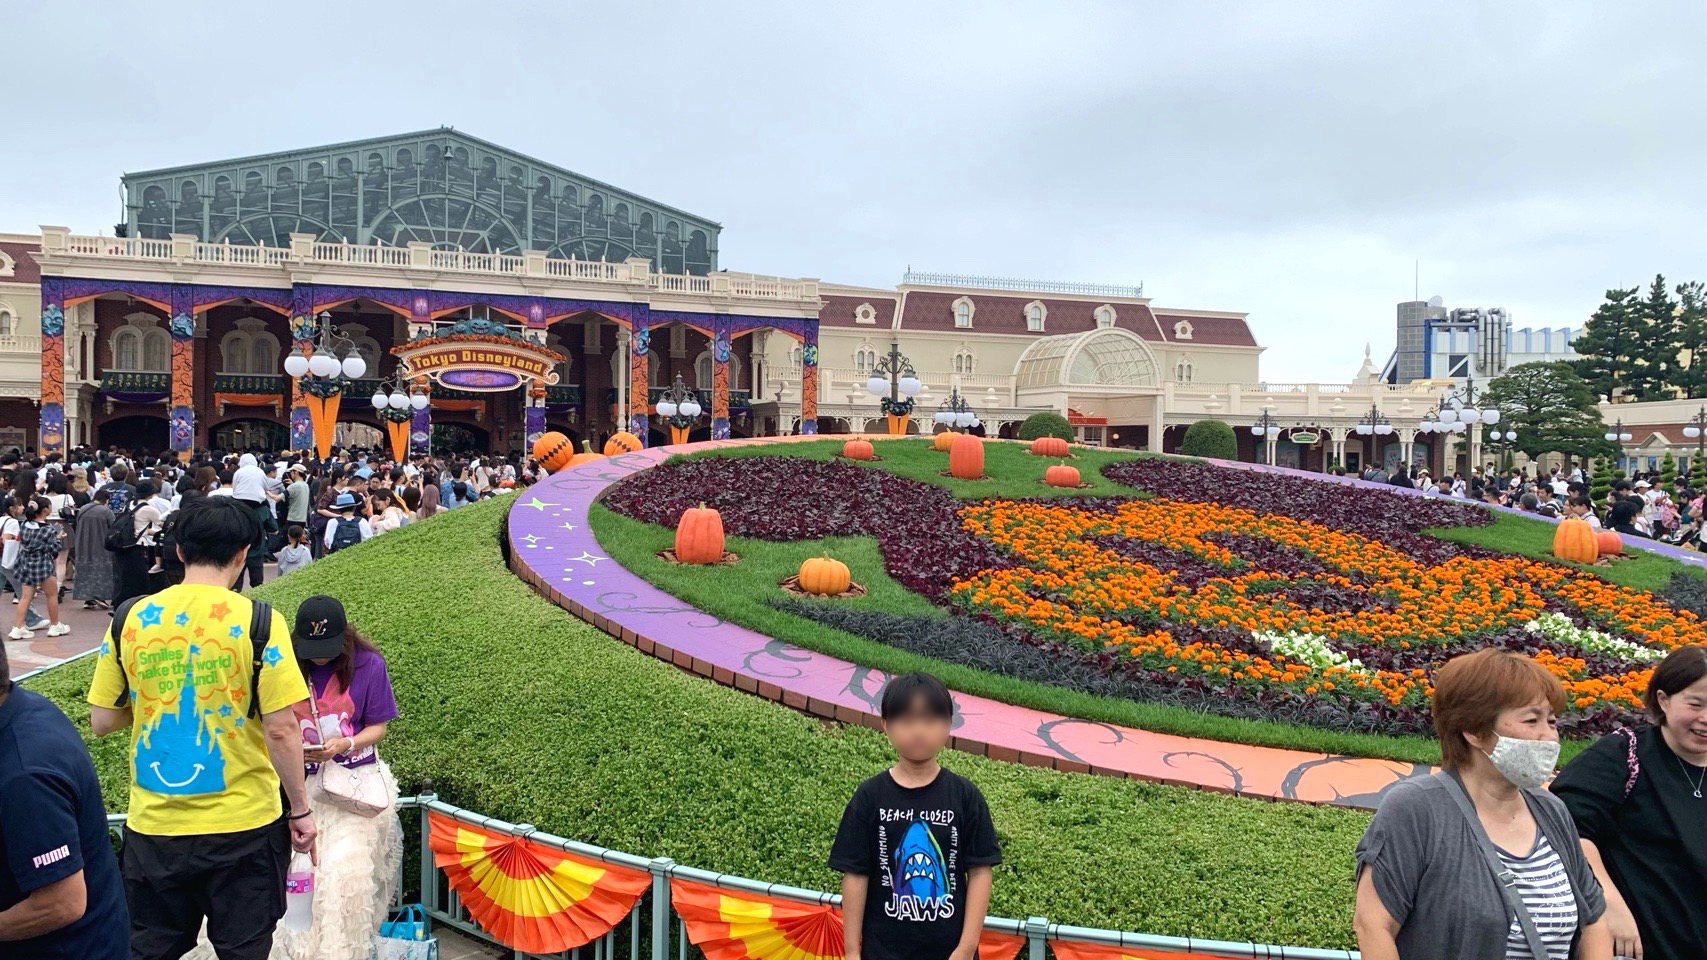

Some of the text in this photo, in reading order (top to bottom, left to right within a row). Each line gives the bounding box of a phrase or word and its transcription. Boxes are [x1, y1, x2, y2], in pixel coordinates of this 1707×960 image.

[413, 351, 543, 373] Tokyo Disneyland
[139, 648, 184, 665] Smiles
[196, 655, 232, 671] world
[158, 680, 174, 694] go
[879, 808, 955, 824] BEACH CLOSED
[950, 826, 958, 847] AMITY
[32, 844, 70, 869] PUMA
[879, 825, 890, 887] NO SWIMMING
[948, 848, 958, 870] POLICE
[884, 893, 955, 922] JAWS
